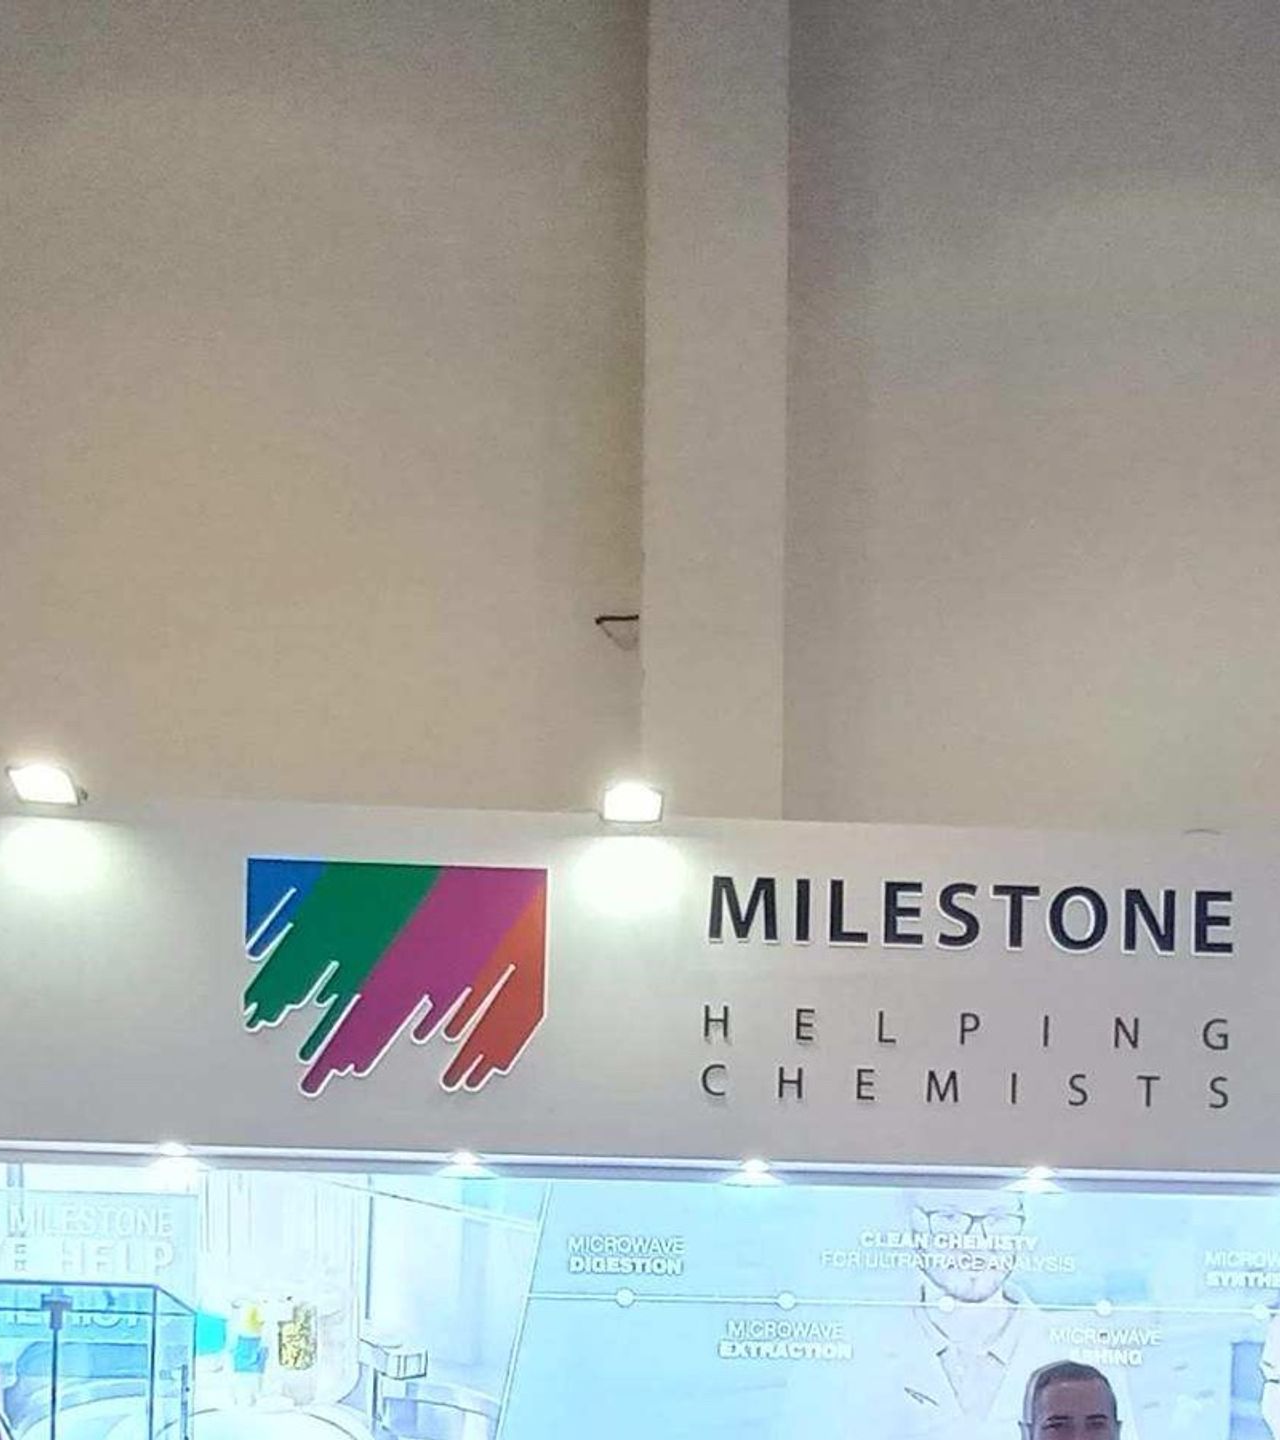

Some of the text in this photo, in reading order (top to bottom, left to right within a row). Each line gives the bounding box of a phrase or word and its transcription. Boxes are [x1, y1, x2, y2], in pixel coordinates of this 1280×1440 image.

[709, 876, 1234, 954] MILESTONE
[703, 1004, 1228, 1051] HELPING
[701, 1063, 1229, 1108] CHEMISTS
[9, 1204, 175, 1237] MILESTONE
[568, 1236, 686, 1255] MICROWAVE
[860, 1231, 928, 1249] CLEAN
[61, 1241, 175, 1275] HELP
[569, 1256, 683, 1275] DIGESTION
[822, 1252, 1076, 1272] FOR ULTRATRACE ANALYSIS
[726, 1320, 843, 1339] MICROWAVE
[1049, 1328, 1163, 1346] MICROWAVE
[718, 1340, 853, 1359] EXTRACTION
